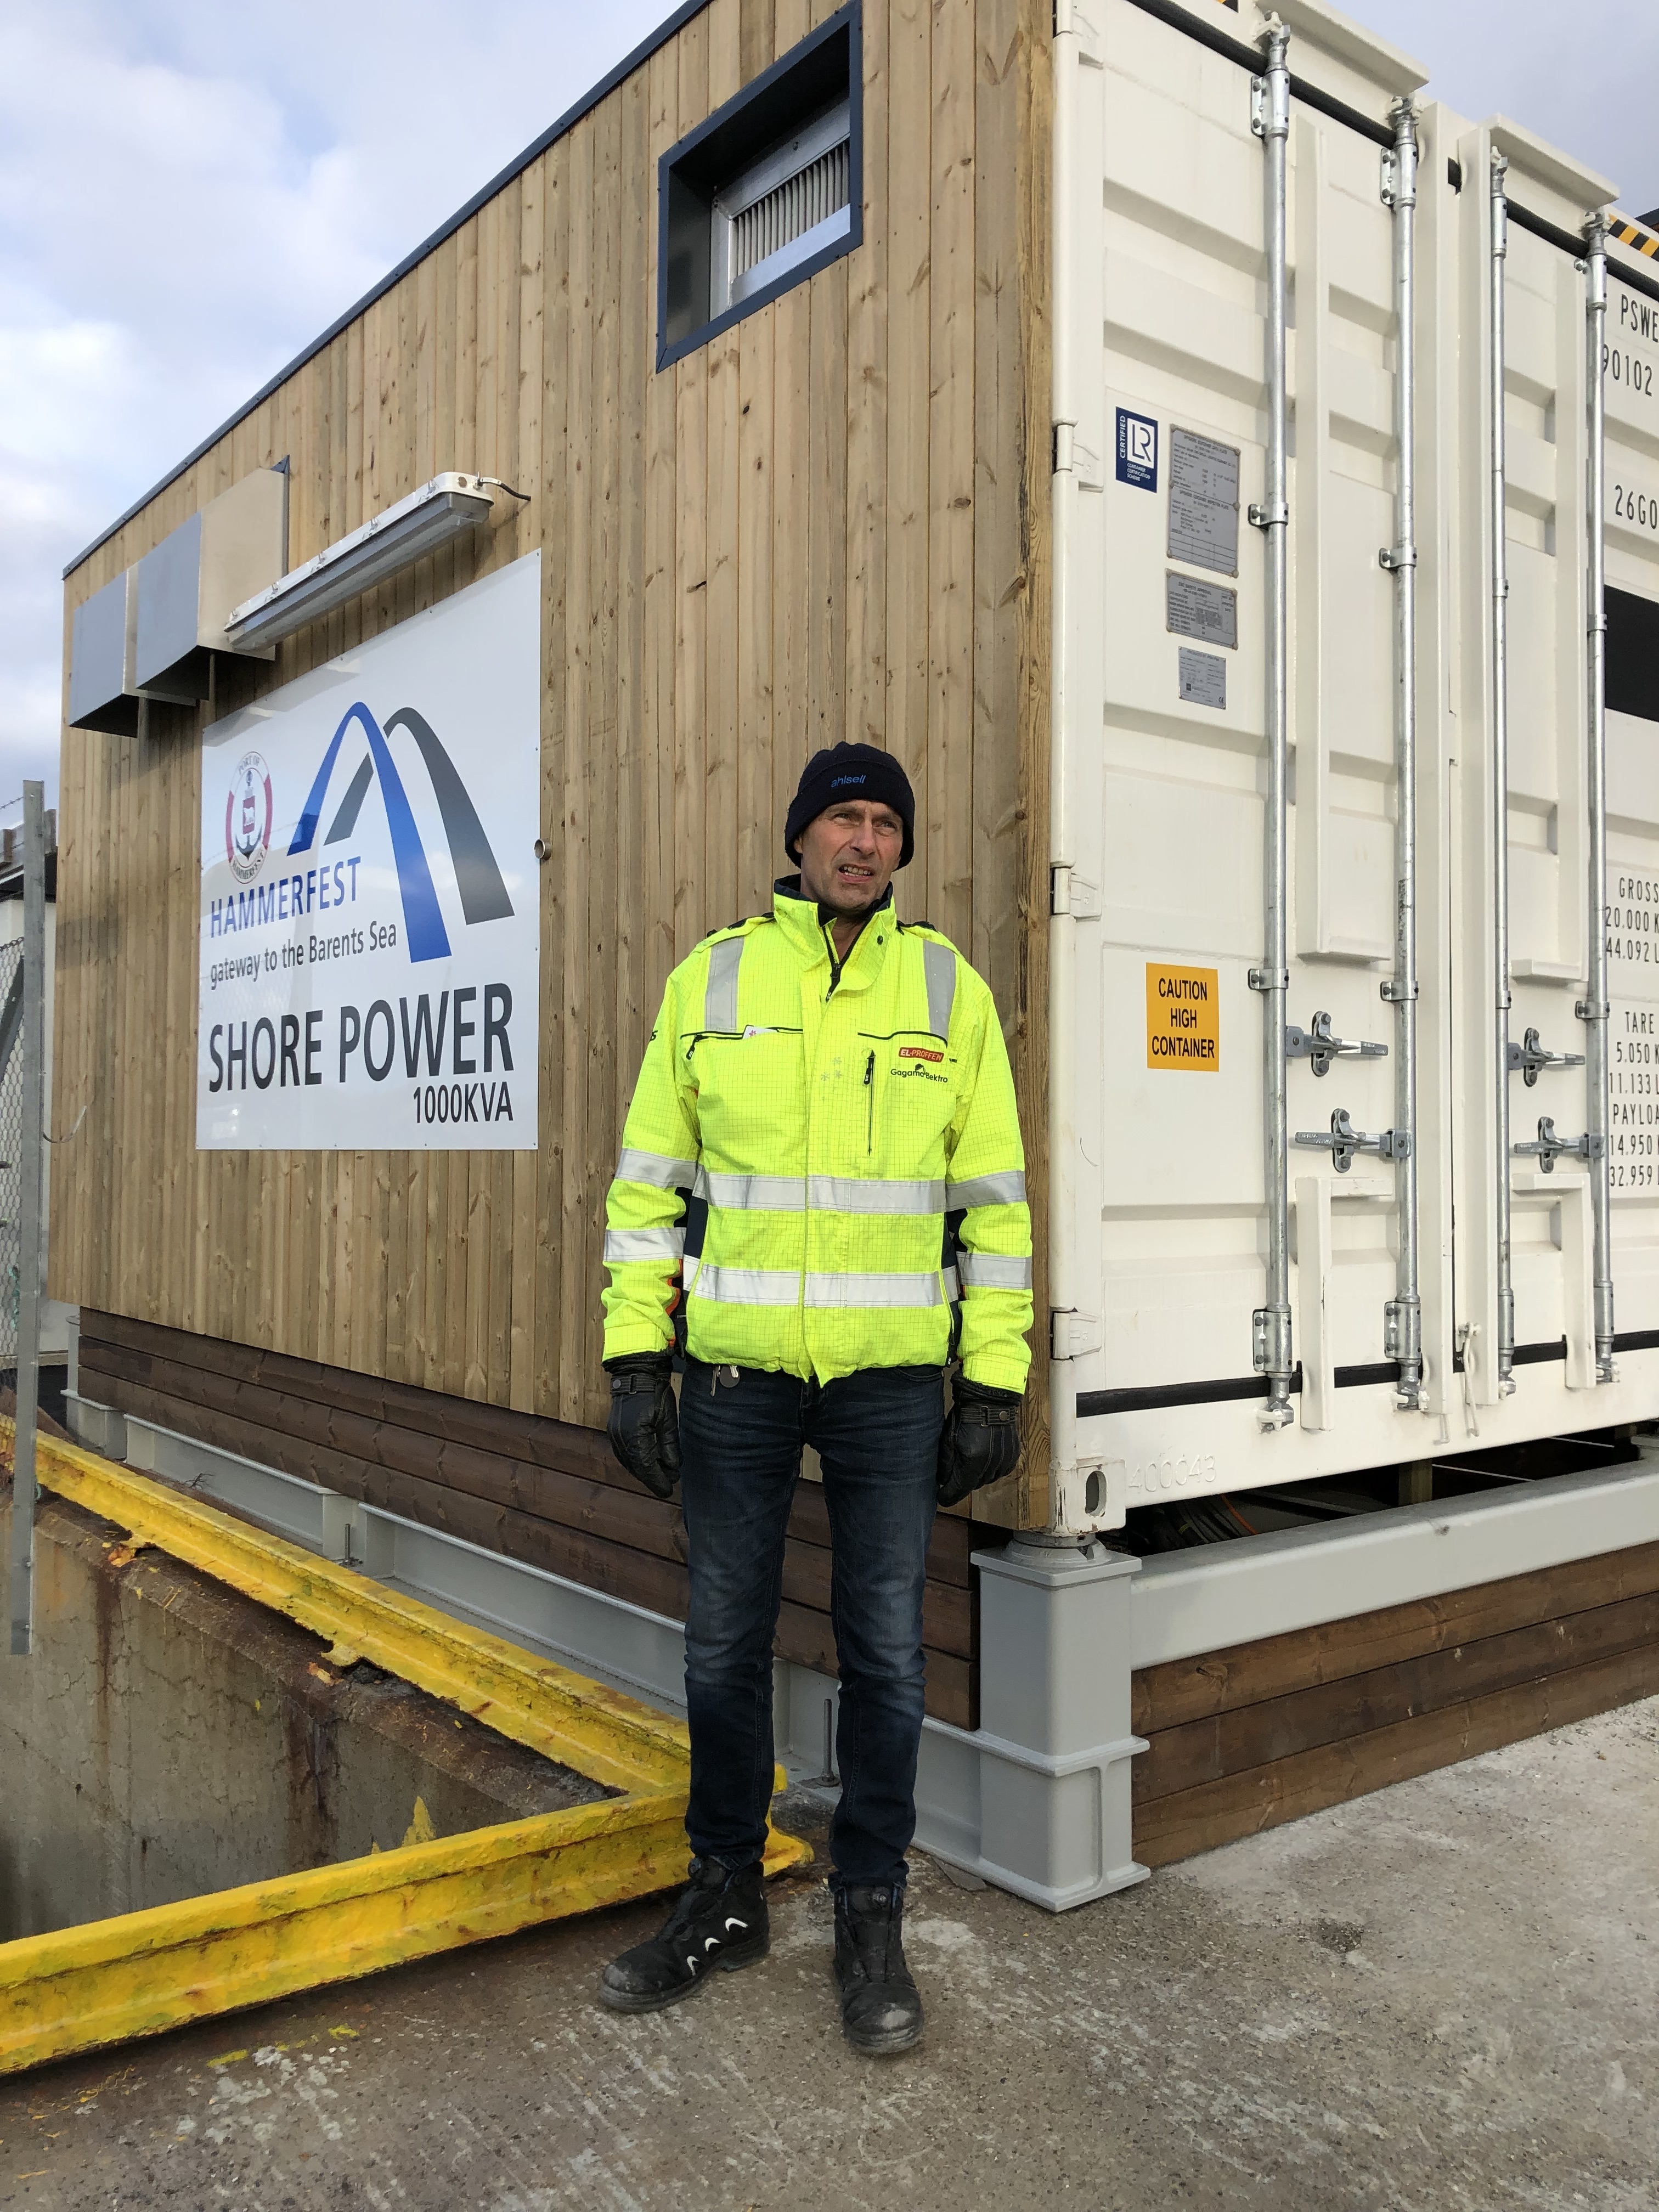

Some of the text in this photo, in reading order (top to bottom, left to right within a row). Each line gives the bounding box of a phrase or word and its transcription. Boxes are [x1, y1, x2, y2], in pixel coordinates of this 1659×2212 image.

[1621, 294, 1658, 342] PSWE
[1615, 484, 1657, 530] 26G0
[831, 774, 866, 788] ahlsell
[210, 856, 362, 938] HAMMERFEST
[1619, 877, 1659, 904] GROSS
[1605, 905, 1650, 932] 20.000
[210, 920, 397, 991] gateway to the Barents Sea
[1606, 936, 1650, 962] 44.092
[1158, 977, 1207, 1001] CAUTION
[1170, 1007, 1197, 1029] HIGH
[1625, 1011, 1655, 1034] TARE
[208, 982, 515, 1093] SHORE POWER
[1152, 1035, 1215, 1059] CONTAINER
[900, 1048, 943, 1062] EL-PROFFEN
[1616, 1041, 1650, 1064] 5.050
[890, 1068, 924, 1078] Gagama
[1610, 1072, 1651, 1094] 11.133
[413, 1081, 514, 1124] 1000KVA
[1610, 1134, 1652, 1156] 14.950
[1610, 1165, 1653, 1187] 32.959
